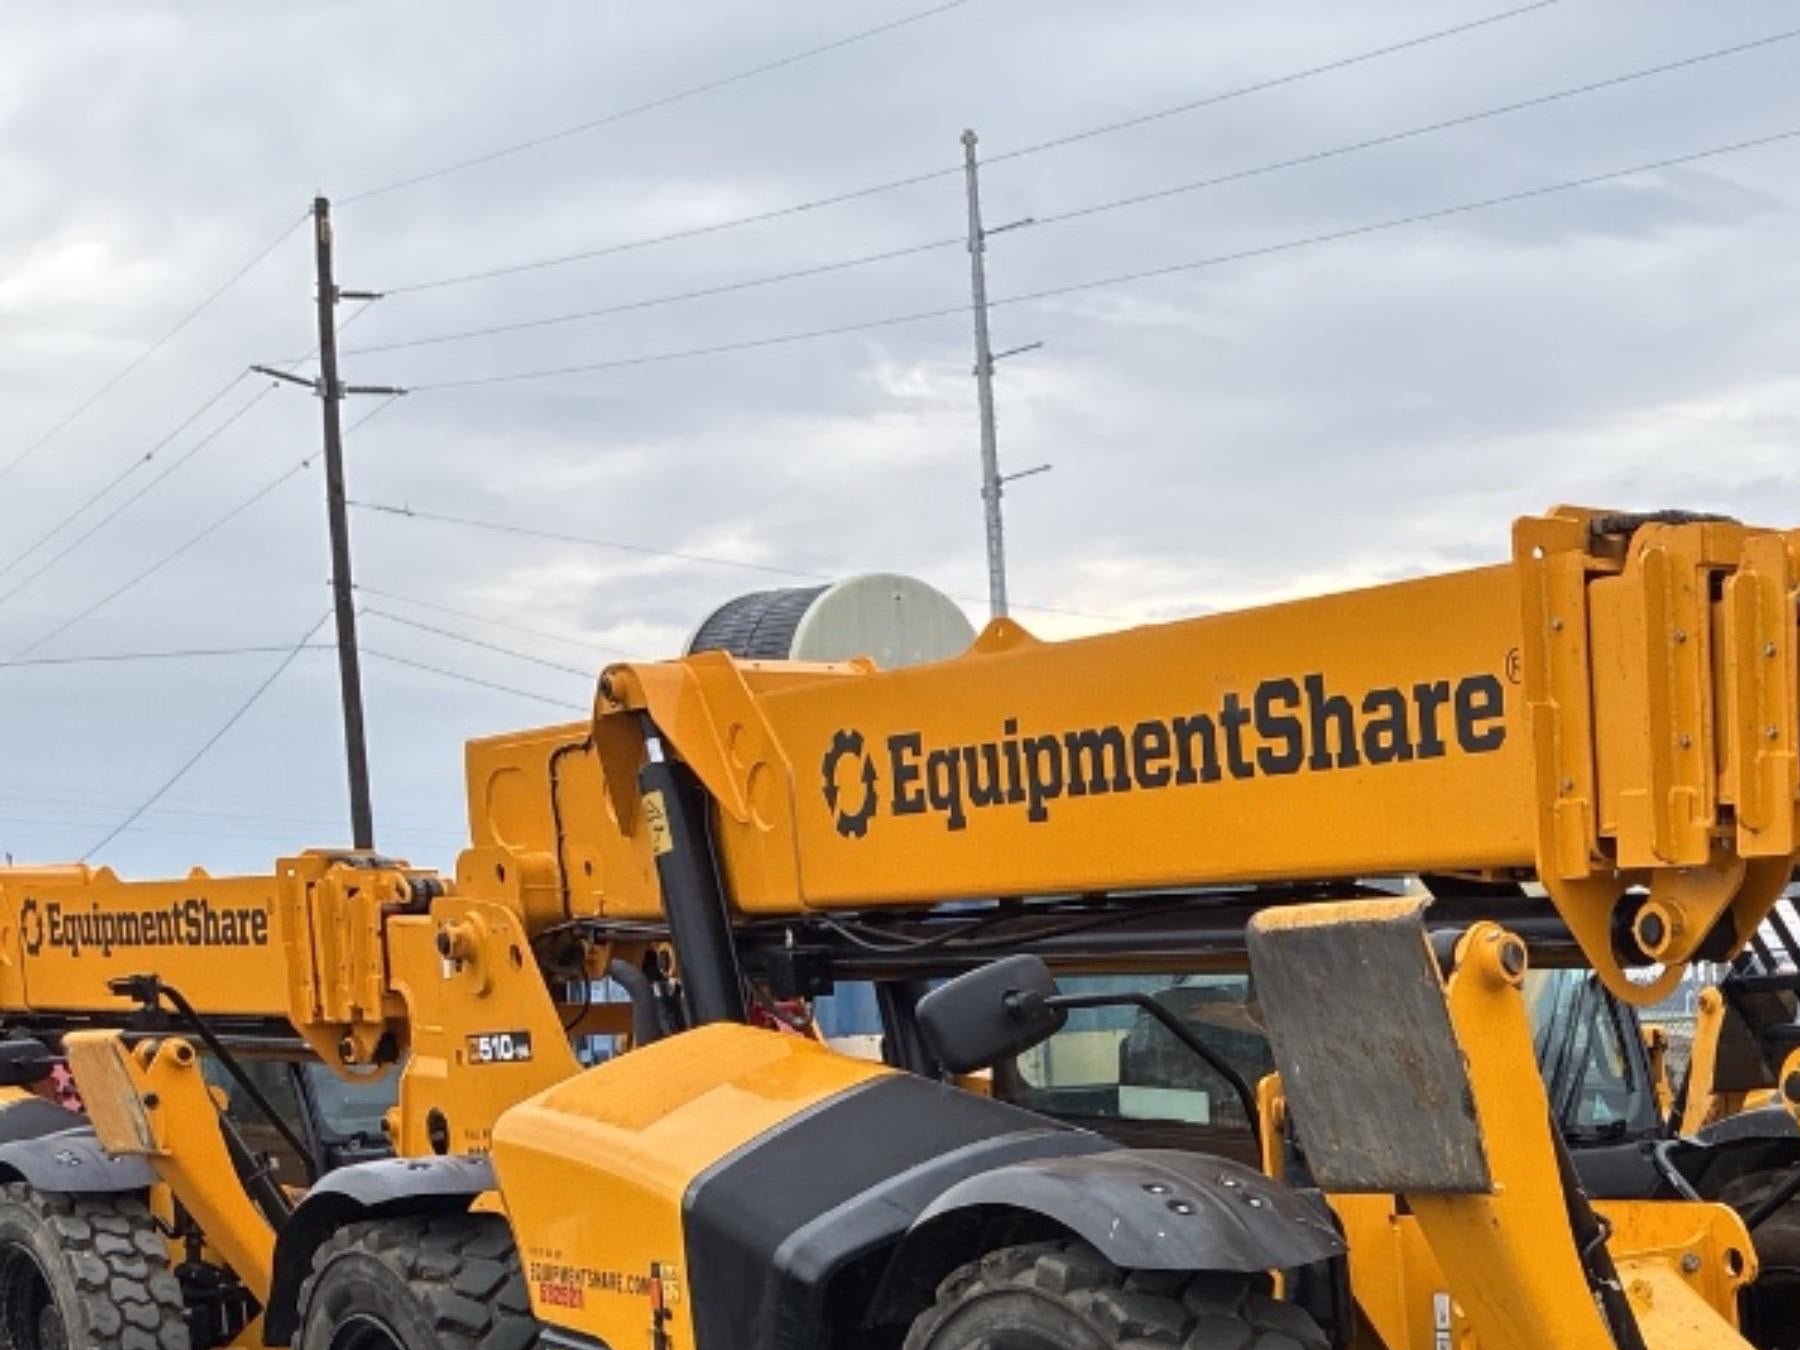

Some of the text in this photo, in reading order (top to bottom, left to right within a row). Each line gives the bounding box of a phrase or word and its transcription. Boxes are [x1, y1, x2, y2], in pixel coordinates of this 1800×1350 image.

[887, 673, 1507, 832] EquipmentShare
[47, 897, 268, 958] EquipmentShare
[479, 1033, 514, 1061] 510
